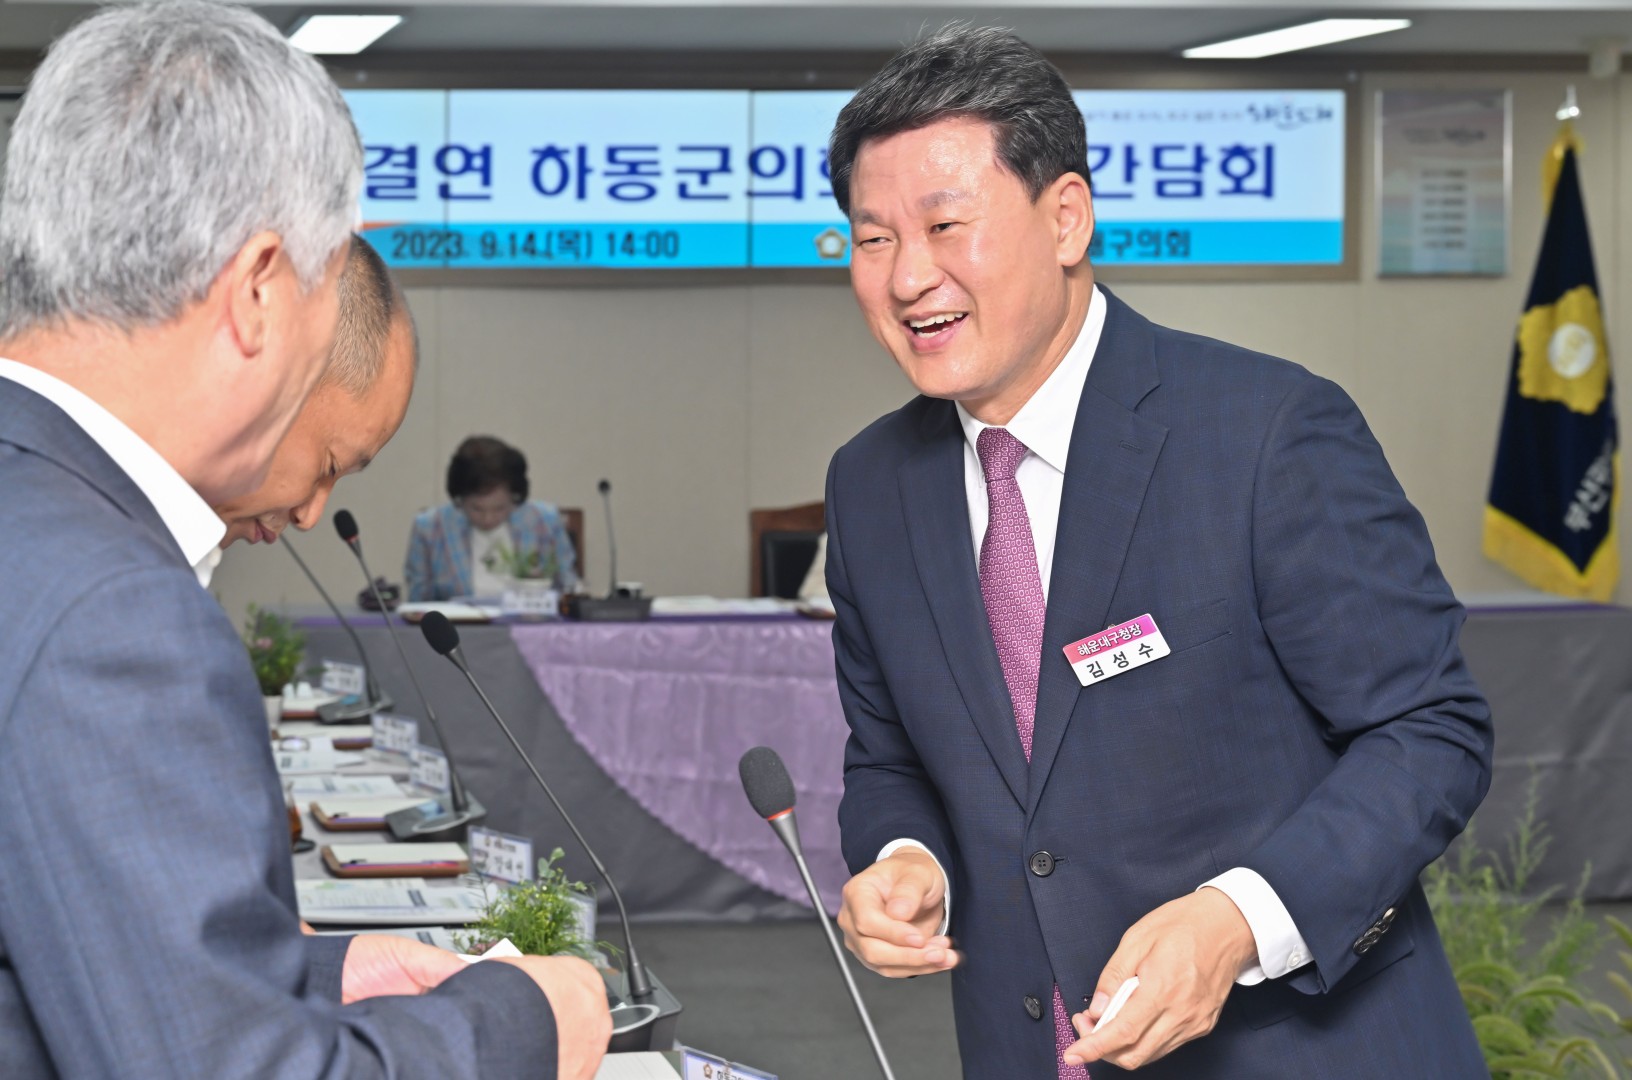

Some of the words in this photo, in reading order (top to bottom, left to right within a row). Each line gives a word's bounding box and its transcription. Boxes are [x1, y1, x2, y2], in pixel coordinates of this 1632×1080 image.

[364, 144, 491, 200] 결연
[1087, 143, 1274, 199] 간담회
[606, 231, 680, 258] 14:00
[1077, 623, 1142, 656] 해운대구청장
